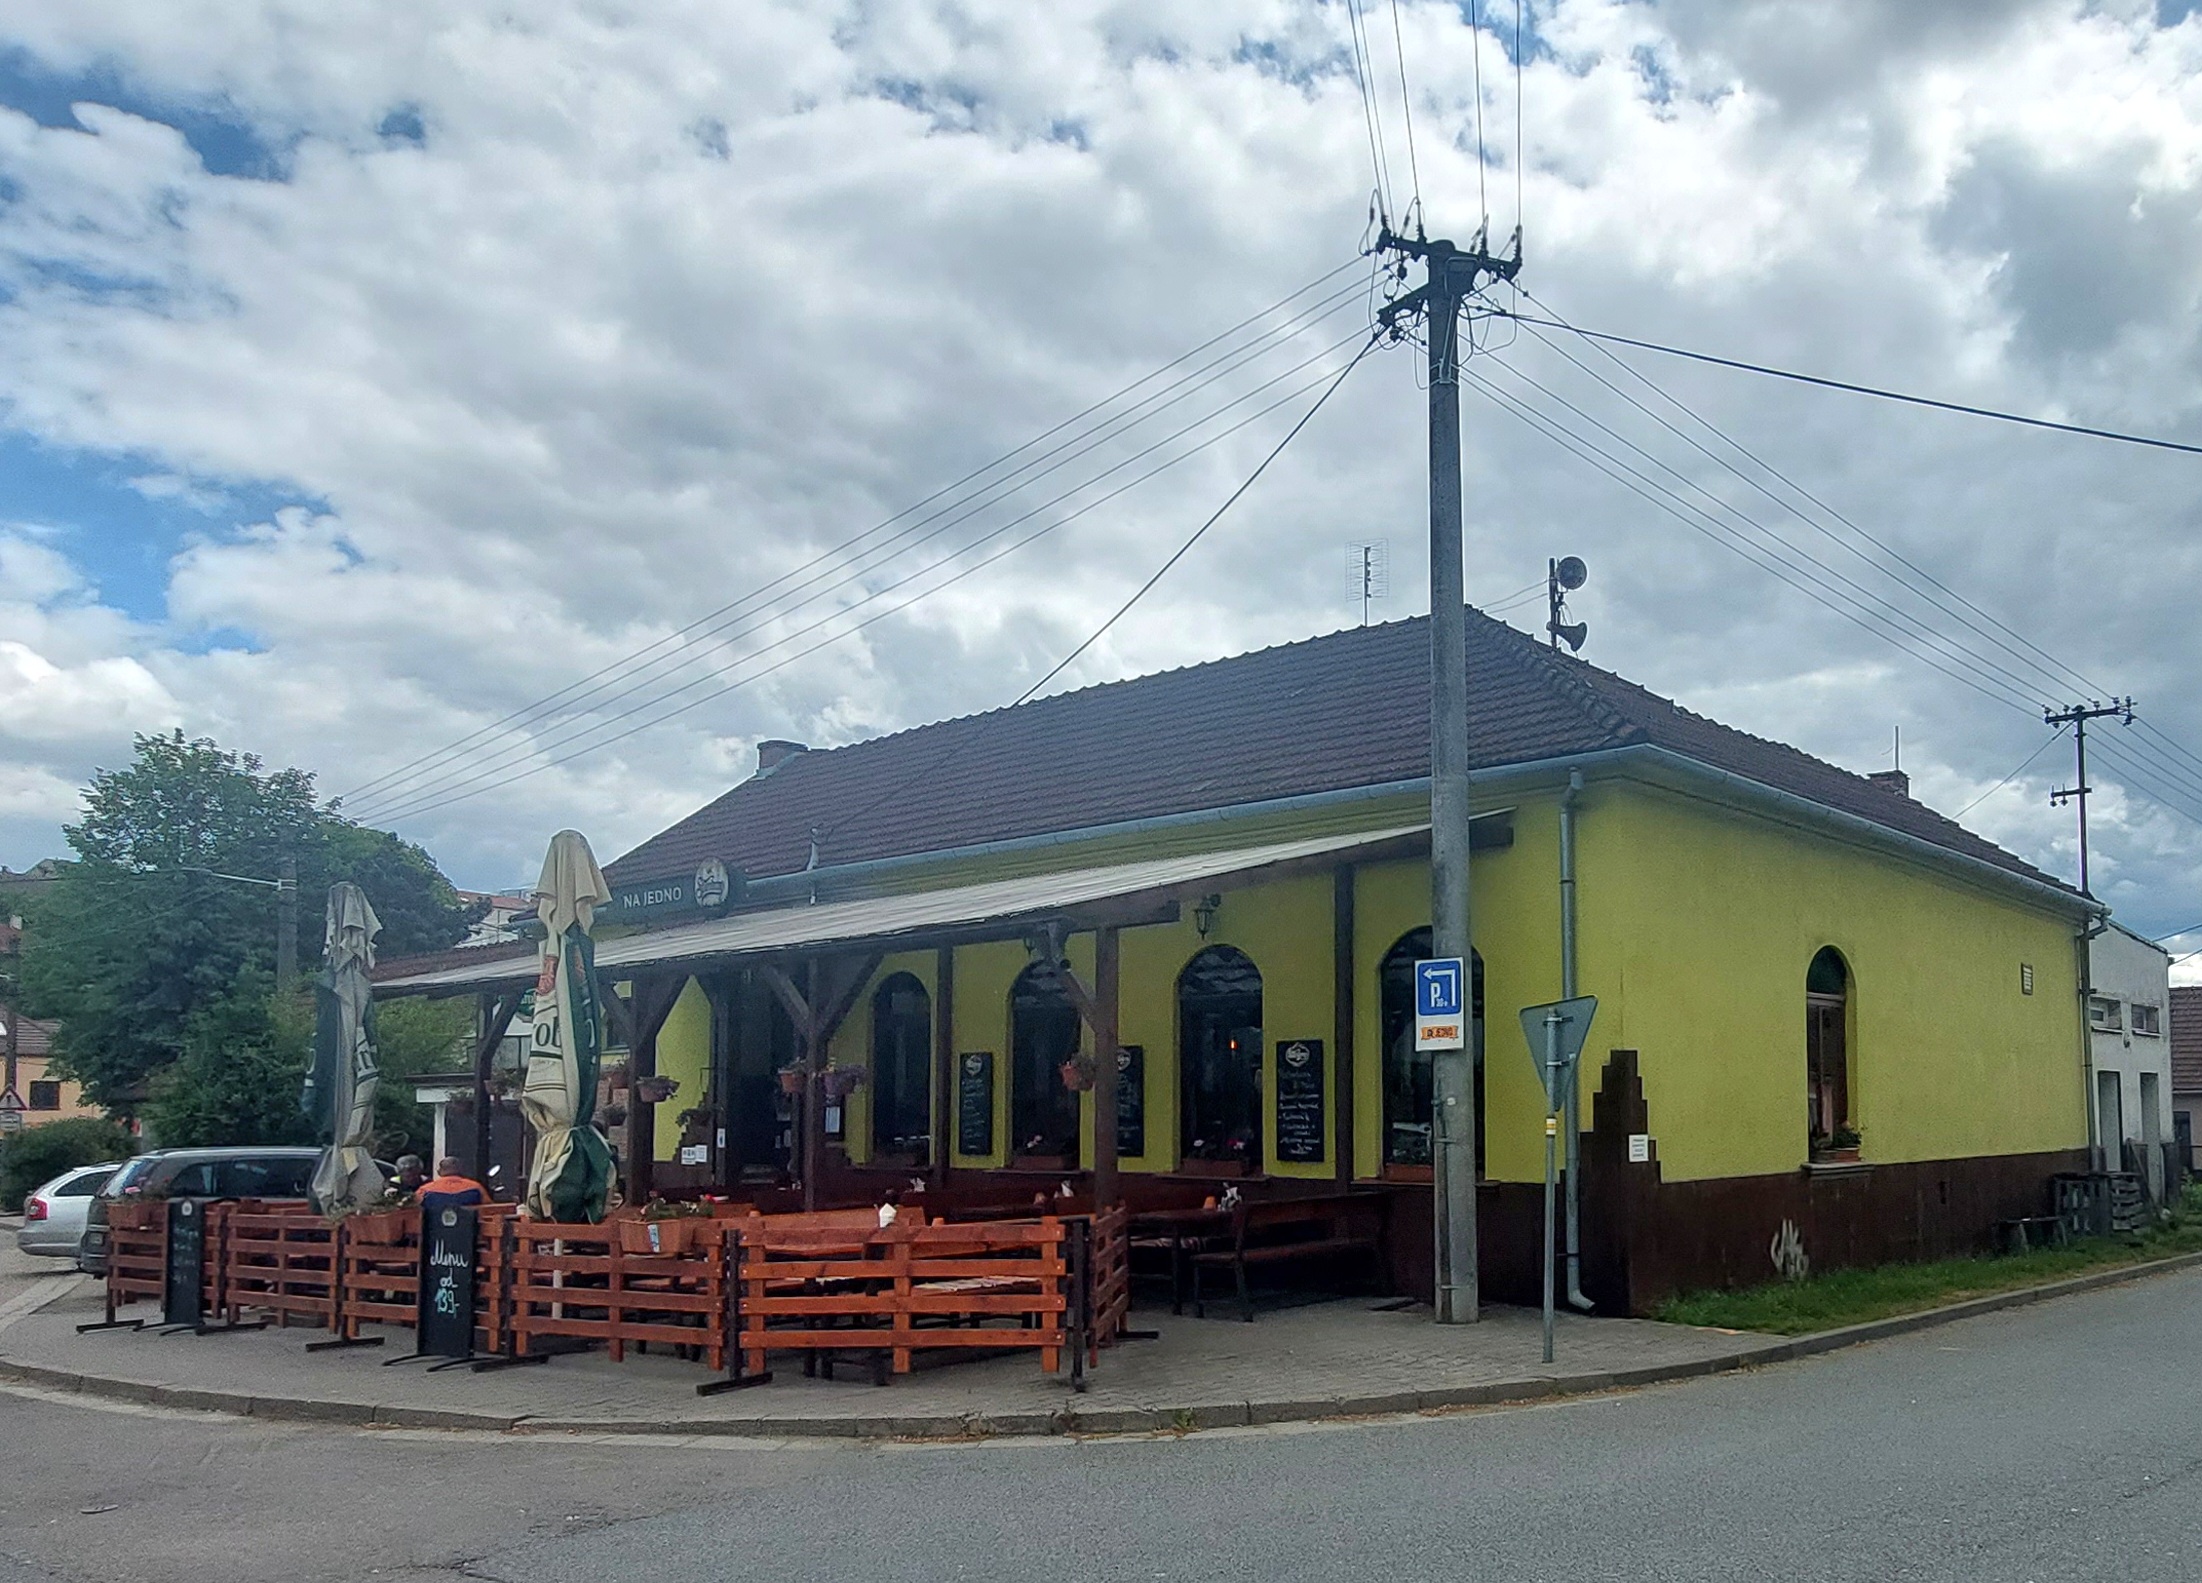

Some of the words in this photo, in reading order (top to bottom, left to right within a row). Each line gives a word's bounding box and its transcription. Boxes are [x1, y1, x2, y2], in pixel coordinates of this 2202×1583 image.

[623, 893, 641, 909] NA
[643, 886, 682, 907] JEDNO
[1430, 982, 1441, 1008] P
[430, 1239, 469, 1268] Menu
